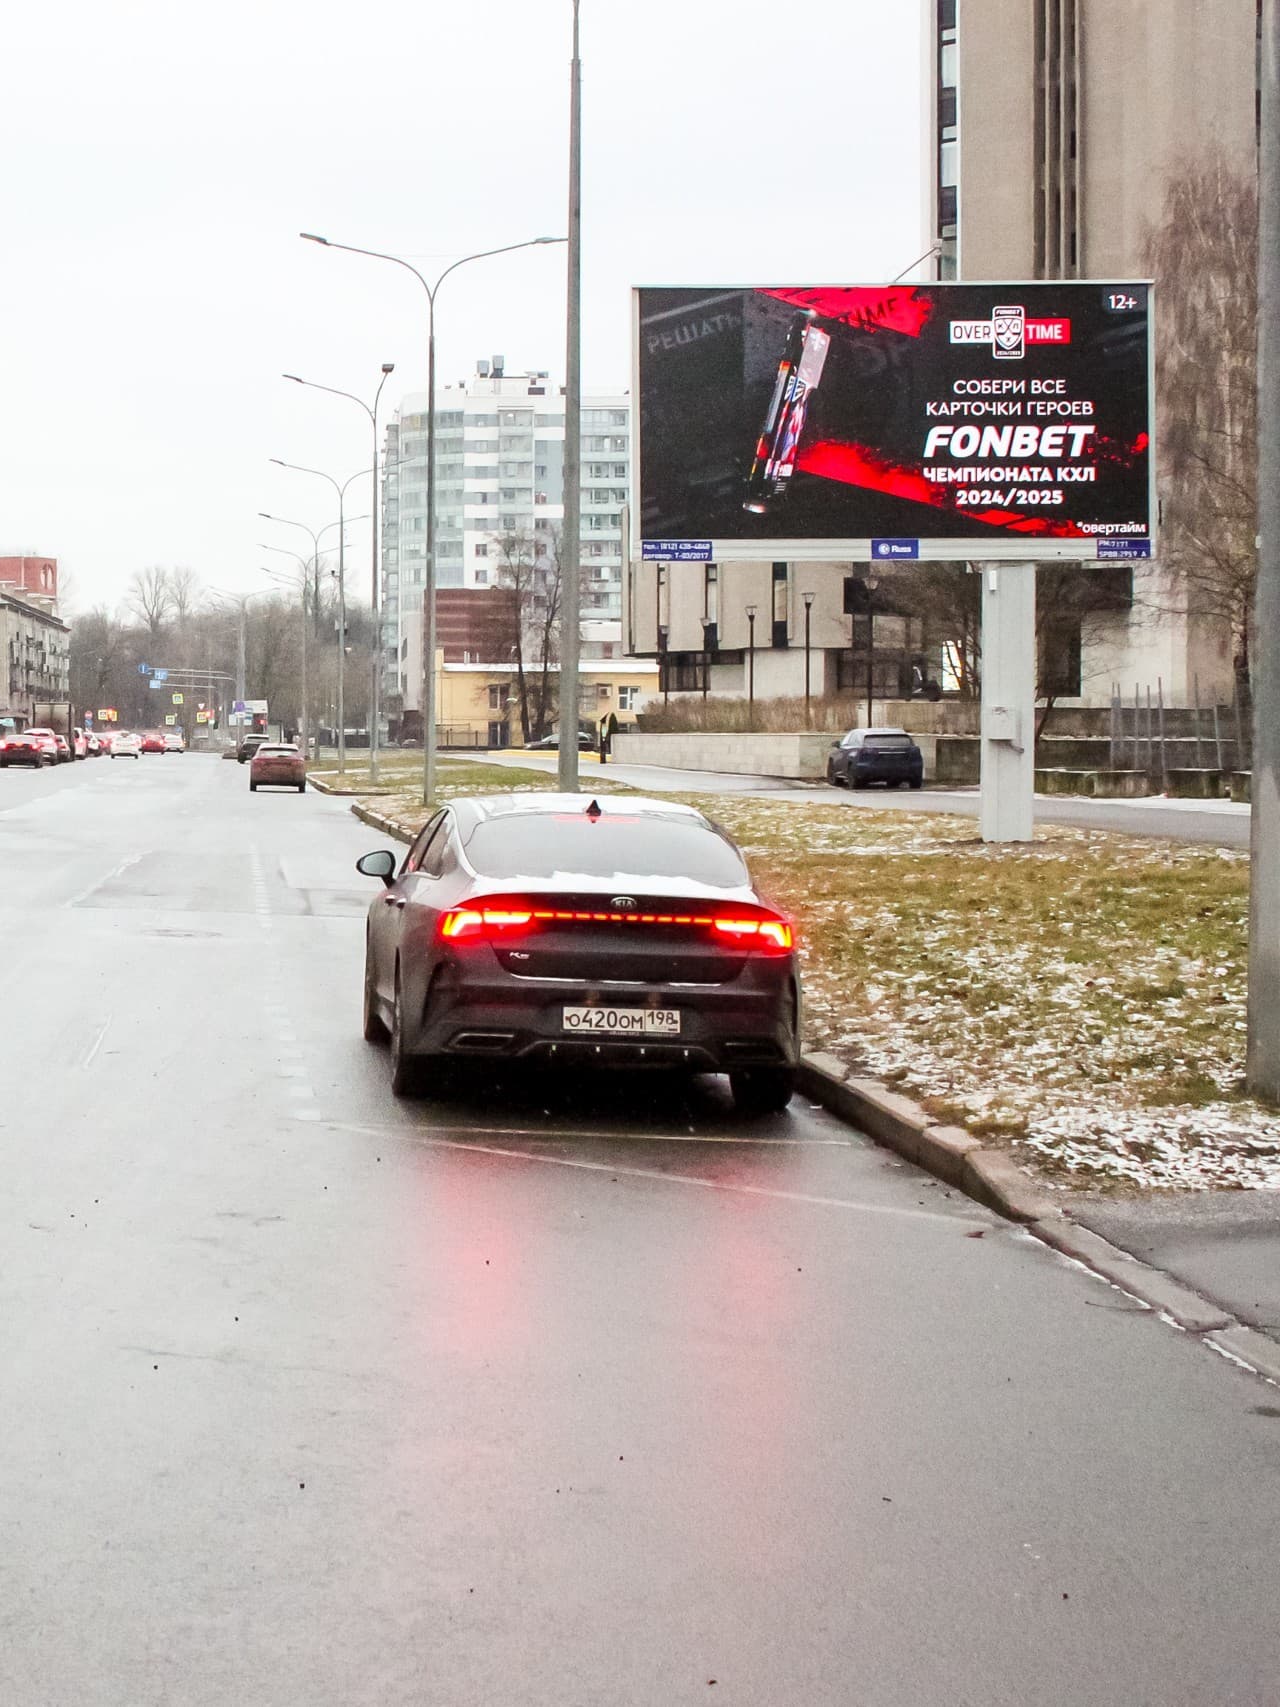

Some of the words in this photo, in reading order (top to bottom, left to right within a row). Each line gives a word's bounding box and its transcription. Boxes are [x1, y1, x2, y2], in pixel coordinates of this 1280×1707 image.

[1109, 295, 1137, 309] 12+
[953, 326, 991, 339] OVER
[1026, 324, 1063, 340] TIME
[953, 380, 1025, 394] СОБЕРИ
[1031, 380, 1066, 394] ВСЕ
[926, 402, 1022, 416] КАРТОЧКИ
[1026, 401, 1094, 416] ГЕРОЕВ
[923, 425, 1095, 458] FONBET
[923, 467, 1053, 482] ЧЕМПИОНАТА
[1056, 467, 1095, 481] КХЛ
[956, 488, 1063, 506] 2024/2025
